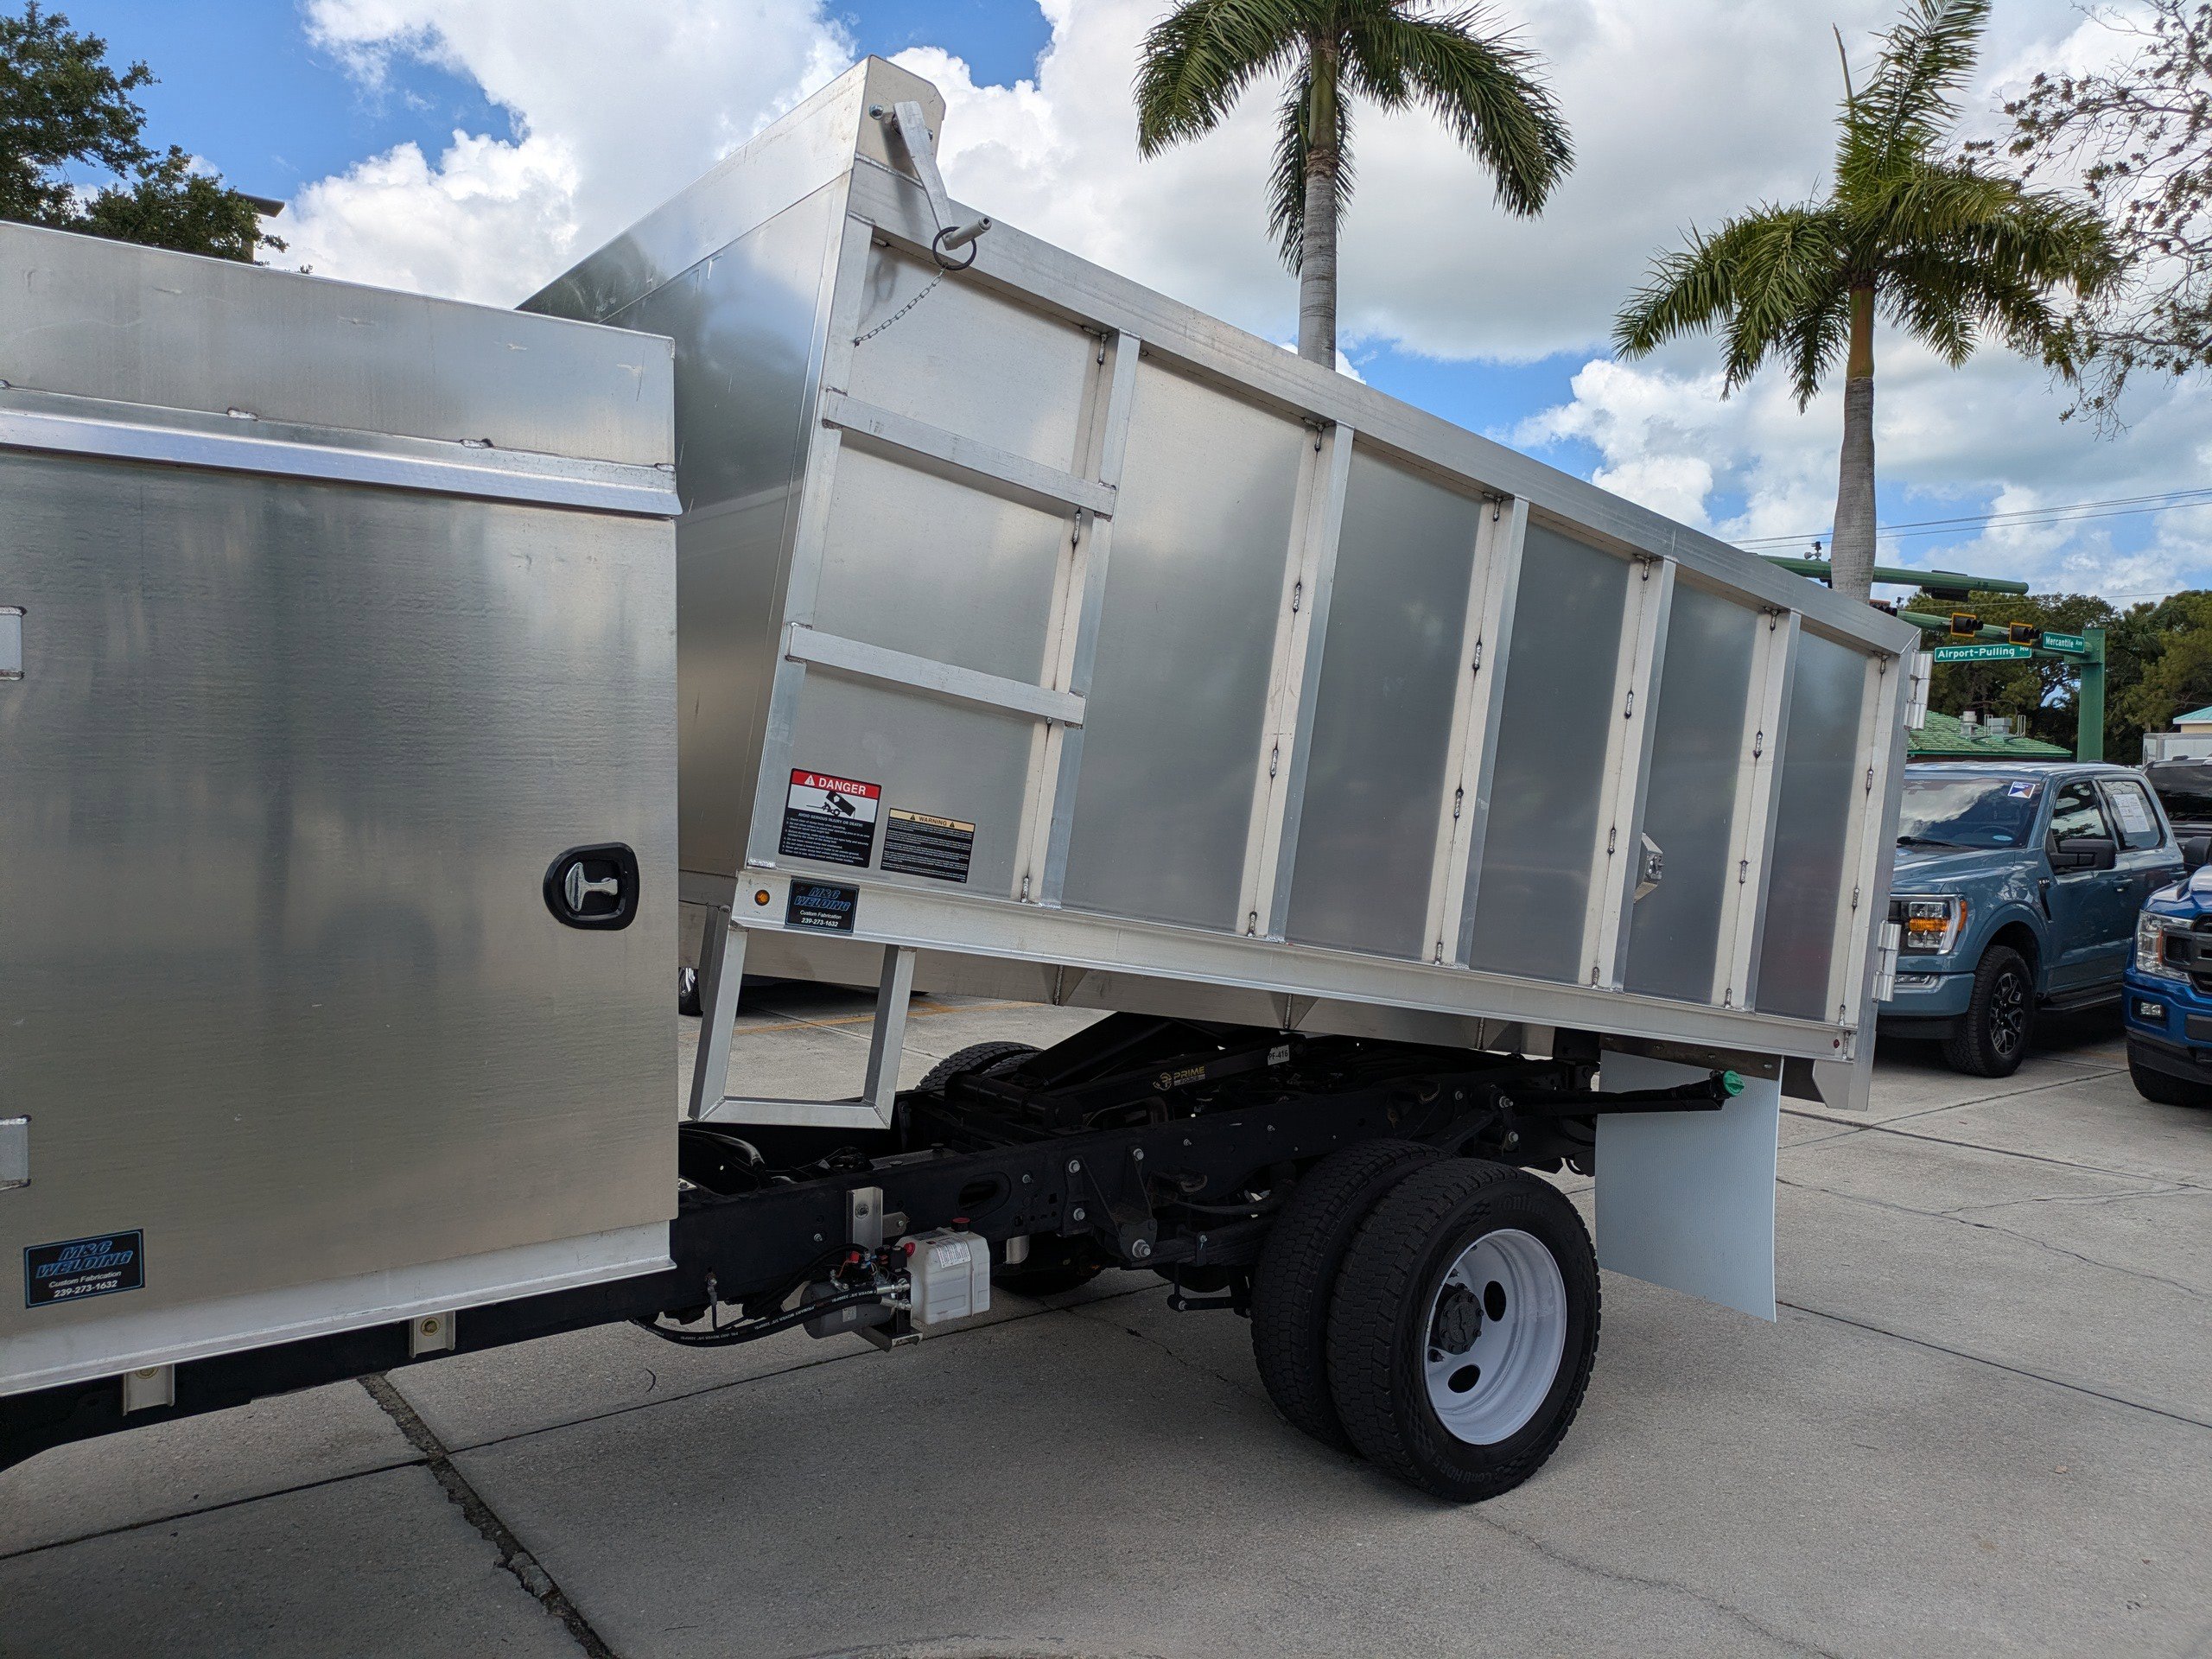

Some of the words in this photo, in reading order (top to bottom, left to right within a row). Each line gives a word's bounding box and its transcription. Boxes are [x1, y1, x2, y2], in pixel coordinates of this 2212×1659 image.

[2046, 636, 2074, 648] Mercantile
[1937, 646, 2015, 659] Airport-Pulling
[818, 778, 866, 795] DANGER
[919, 816, 947, 826] WARNING
[794, 895, 851, 911] WELDING
[801, 918, 838, 927] 239-273-1632
[1173, 1065, 1205, 1080] PRIME
[35, 1250, 133, 1279] WELDING
[48, 1279, 79, 1288] Custom
[79, 1270, 122, 1282] Fabrication
[54, 1280, 118, 1298] 239-273-1632
